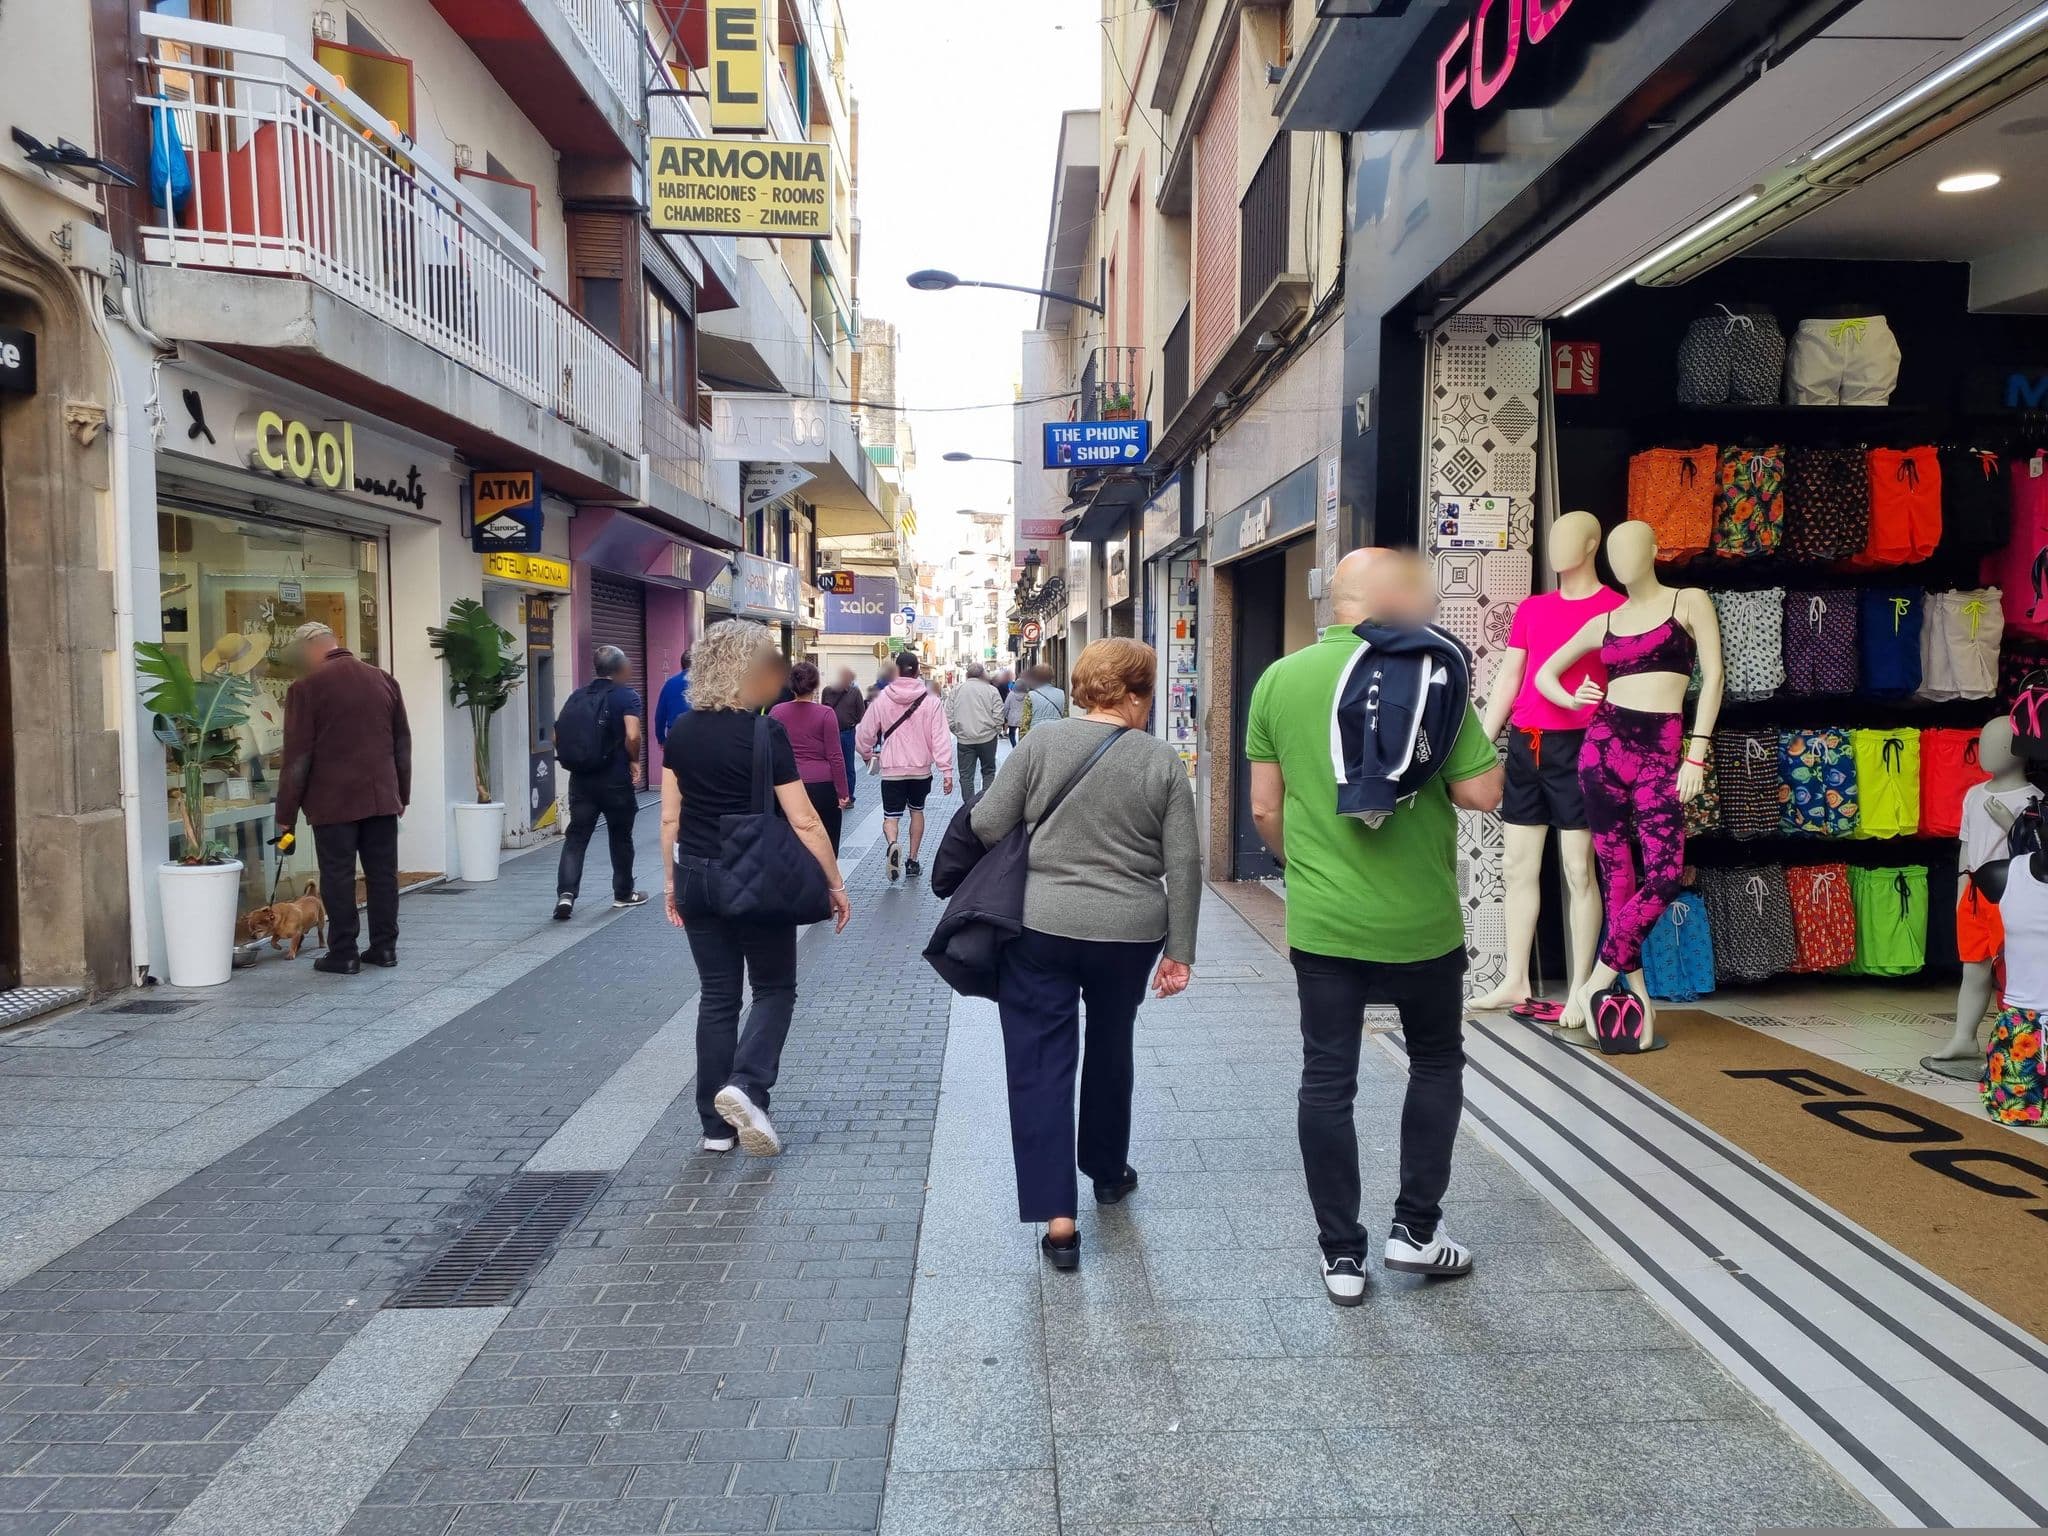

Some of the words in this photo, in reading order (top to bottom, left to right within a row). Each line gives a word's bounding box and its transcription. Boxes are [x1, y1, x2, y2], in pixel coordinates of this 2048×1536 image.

[657, 146, 826, 182] ARMONIA
[658, 182, 756, 202] HABITACIONES
[772, 187, 825, 204] ROOMS
[664, 205, 741, 223] CHAMBRES
[760, 208, 819, 226] ZIMMER
[716, 415, 827, 447] TATTOO
[1053, 428, 1082, 442] THE
[1086, 426, 1140, 441] PHONE
[1077, 446, 1121, 460] SHOP
[479, 479, 530, 500] ATM
[489, 522, 519, 533] Euronet
[488, 551, 521, 576] HOTEL
[524, 561, 563, 583] ARMONIA
[821, 576, 834, 587] IN
[531, 599, 549, 619] ATM
[840, 597, 885, 615] xaloc
